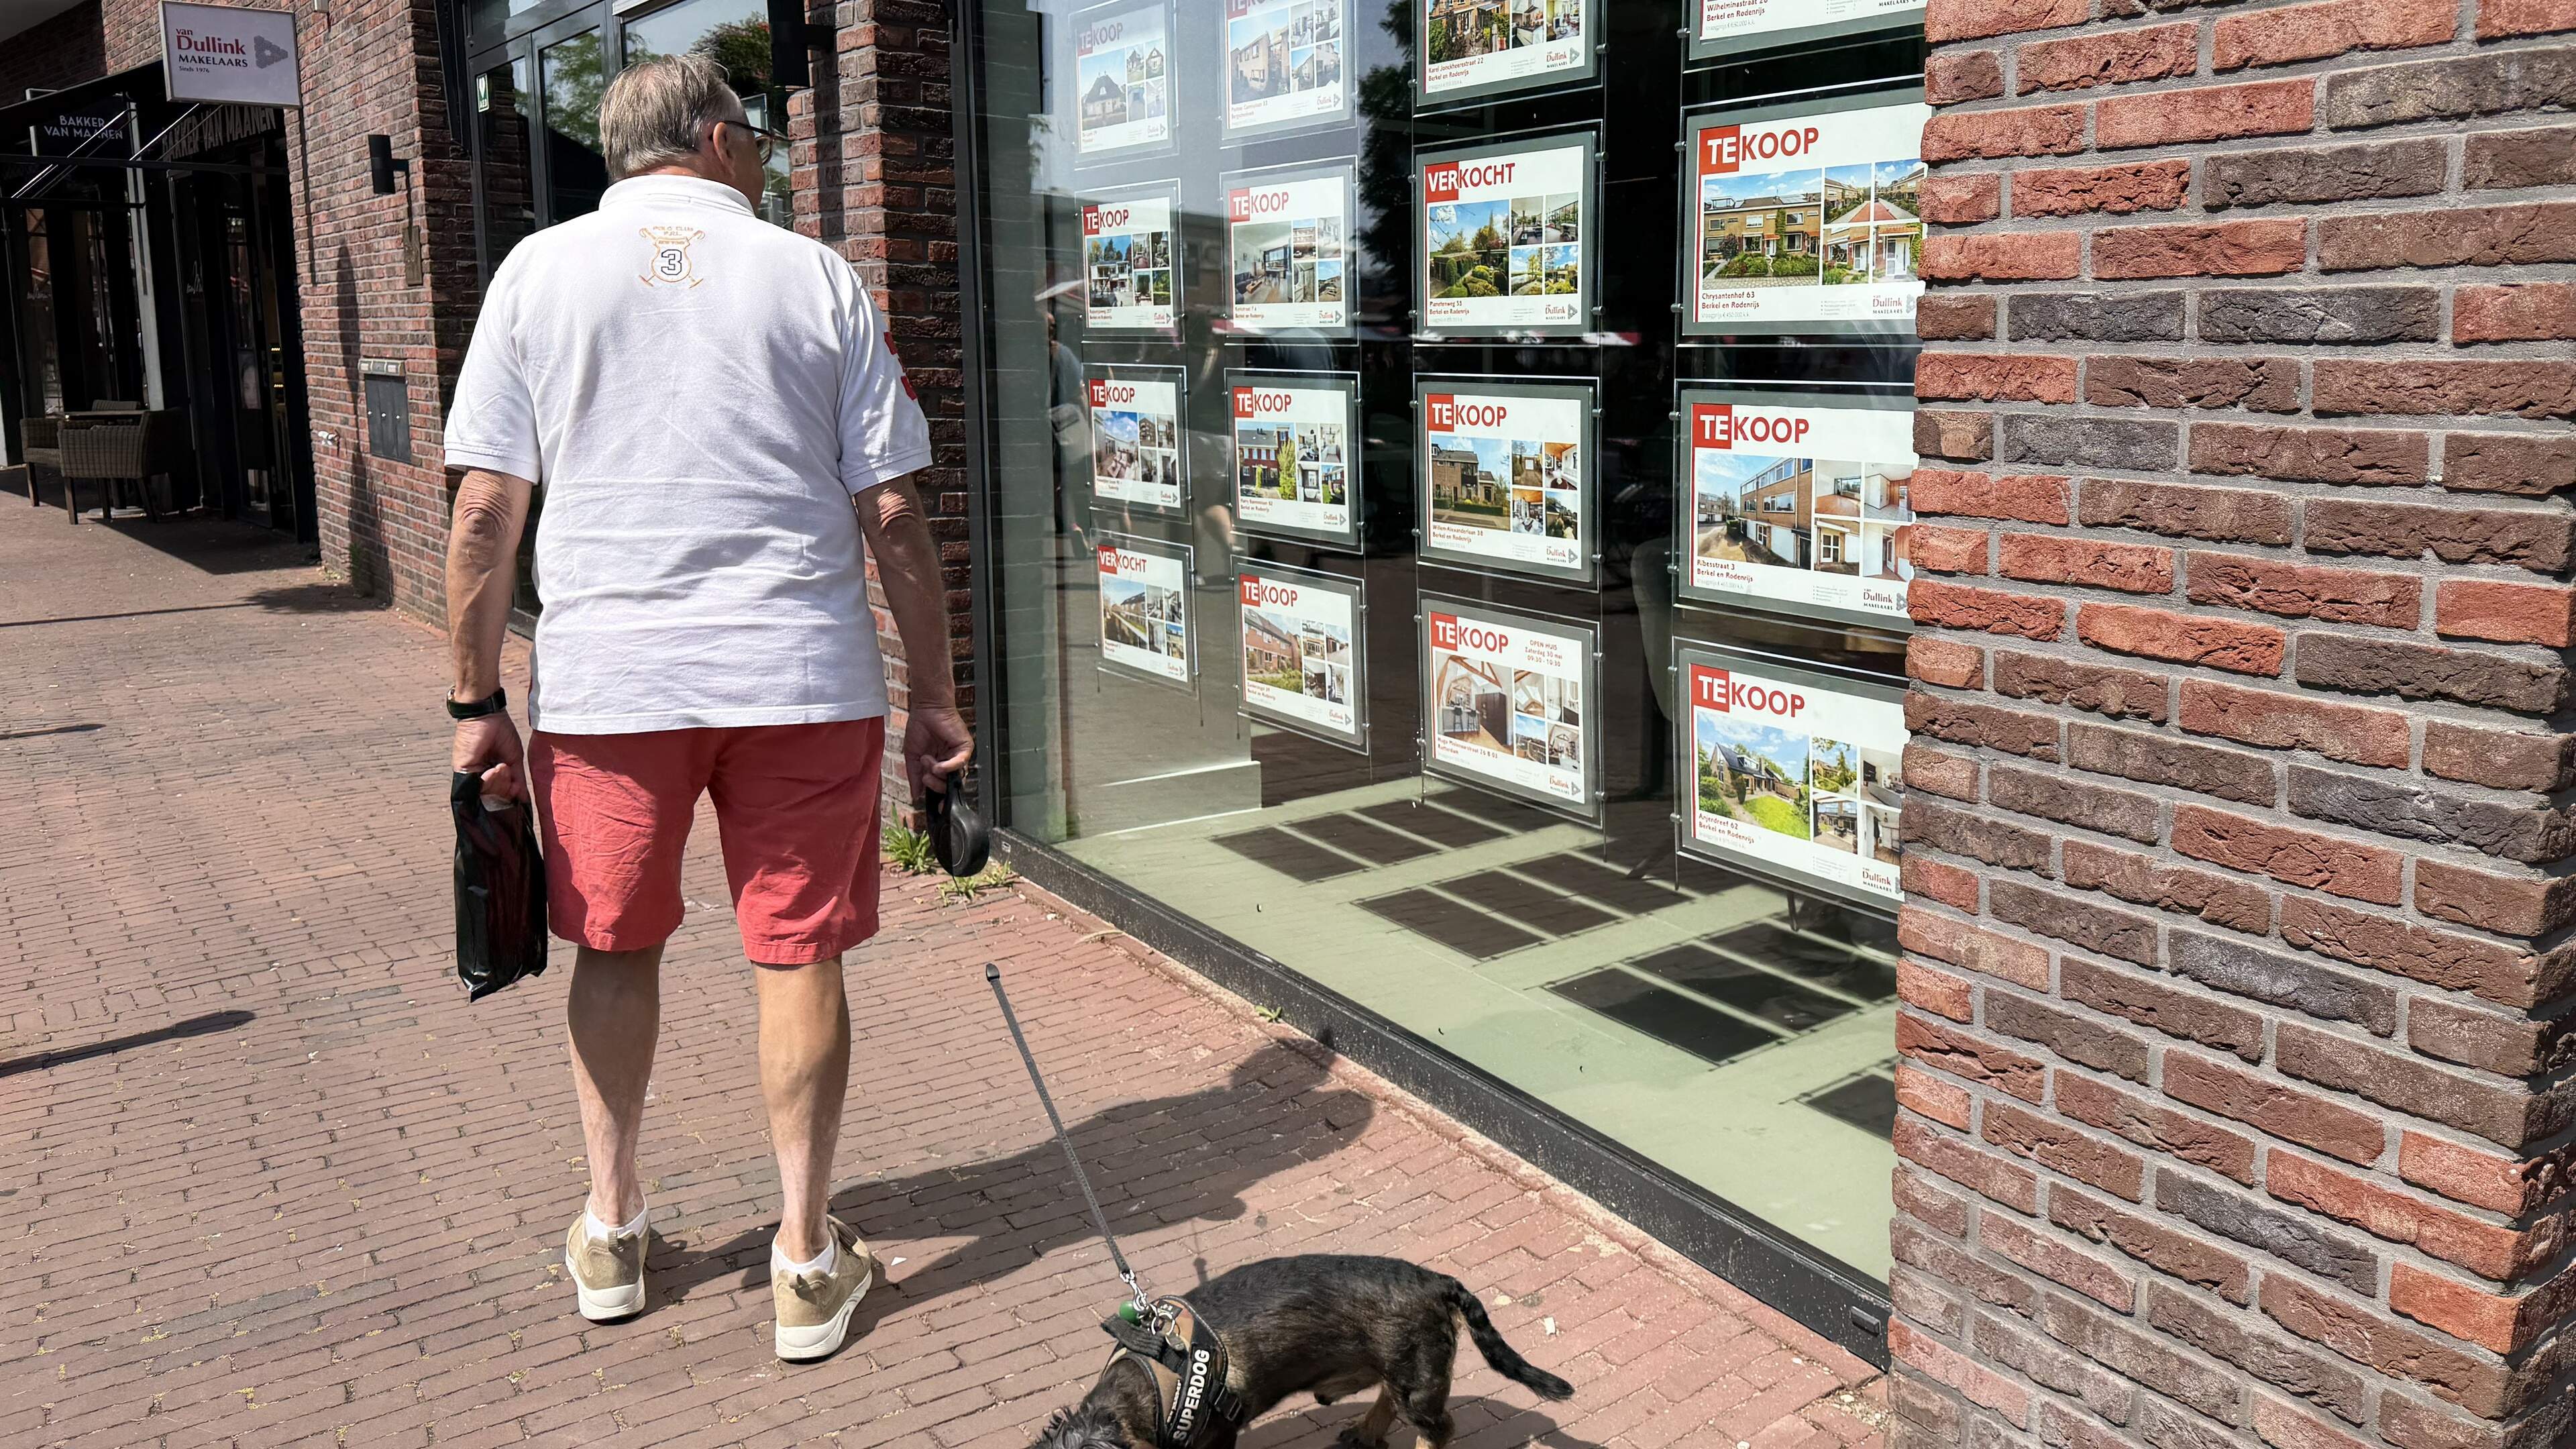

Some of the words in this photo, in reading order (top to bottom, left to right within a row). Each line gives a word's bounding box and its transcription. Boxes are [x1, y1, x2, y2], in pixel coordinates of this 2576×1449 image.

[1707, 13, 1725, 21] Berkel
[1736, 7, 1765, 17] Rodenrijs
[176, 36, 246, 55] Dullink
[178, 54, 248, 67] MAKELAARS
[1546, 52, 1567, 62] Dullink
[60, 115, 105, 127] BAKKER
[44, 125, 69, 137] VAN
[1707, 127, 1819, 165] TEKOOP
[1428, 162, 1515, 193] VERKOCHT
[1233, 192, 1289, 215] TEKOOP
[661, 250, 682, 275] 3
[1702, 291, 1744, 301] Chrysantenhof
[1873, 298, 1902, 307] Dullink
[1731, 301, 1760, 309] Rodenrijs
[1093, 386, 1135, 402] TEKOOP
[1236, 393, 1291, 412] TEKOOP
[1432, 403, 1507, 427] TEKOOP
[1700, 415, 1809, 443] TEKOOP
[1546, 548, 1566, 557] Dullink
[1099, 550, 1146, 572] VERKOCHT
[1697, 568, 1715, 576] Berkel
[1725, 572, 1753, 583] Rodenrijs
[1243, 581, 1298, 607] TEKOOP
[1864, 592, 1893, 603] Dullink
[1436, 621, 1509, 653] TEKOOP
[1698, 675, 1805, 718] TEKOOP
[1550, 776, 1569, 789] Dullink
[1699, 813, 1728, 826] Anjerdreef
[1699, 821, 1717, 832] Berkel
[1727, 830, 1754, 844] Rodenrijs
[1863, 871, 1891, 885] Dullink
[1863, 881, 1892, 893] MAKELAARS
[1173, 1348, 1210, 1441] SUPERDOG
